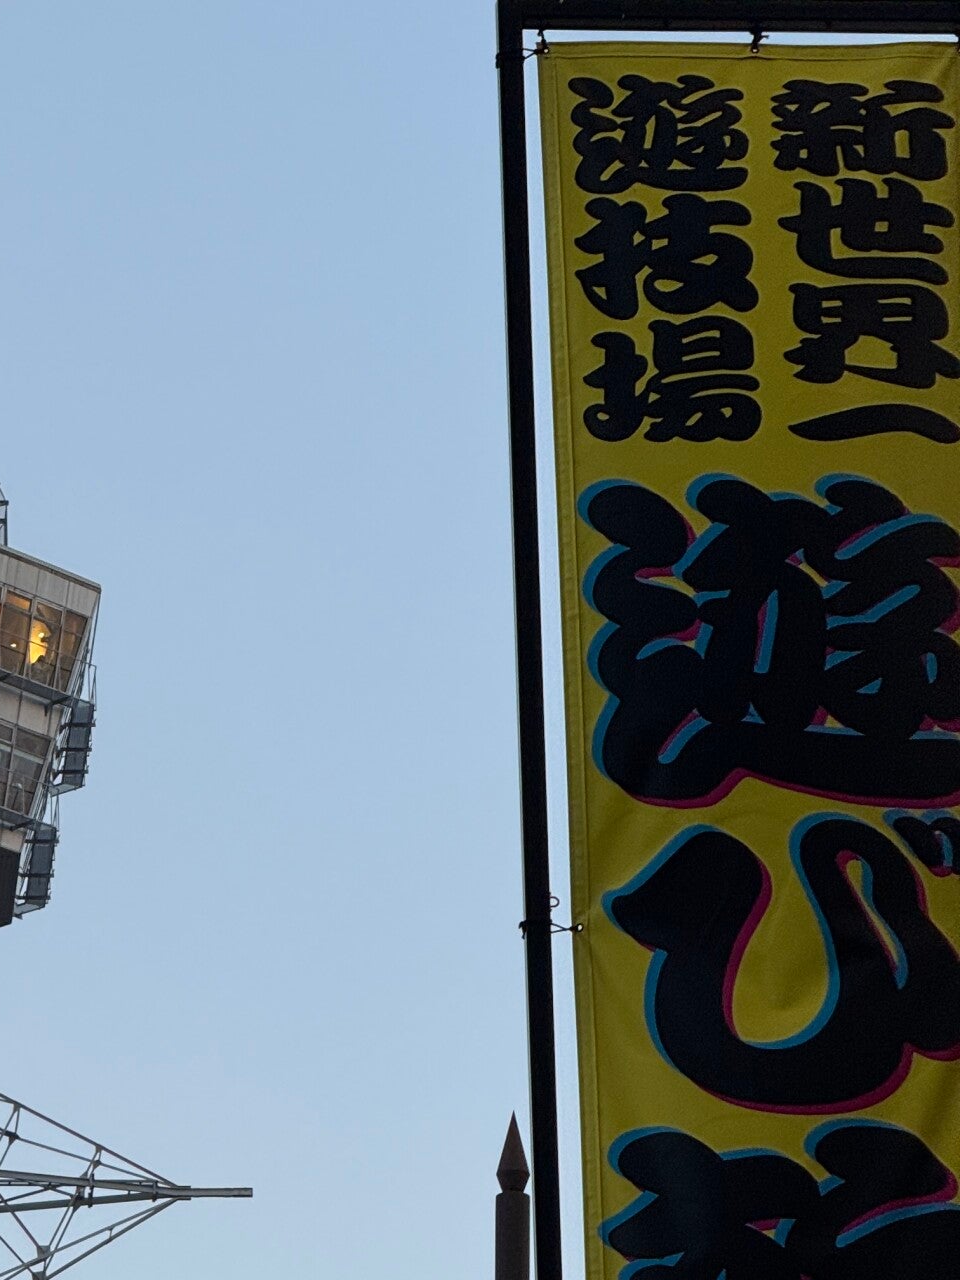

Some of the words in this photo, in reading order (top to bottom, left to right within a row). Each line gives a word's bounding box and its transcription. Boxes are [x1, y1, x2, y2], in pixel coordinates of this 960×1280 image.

[568, 74, 762, 443] 遊技場
[770, 79, 960, 444] 新世界一
